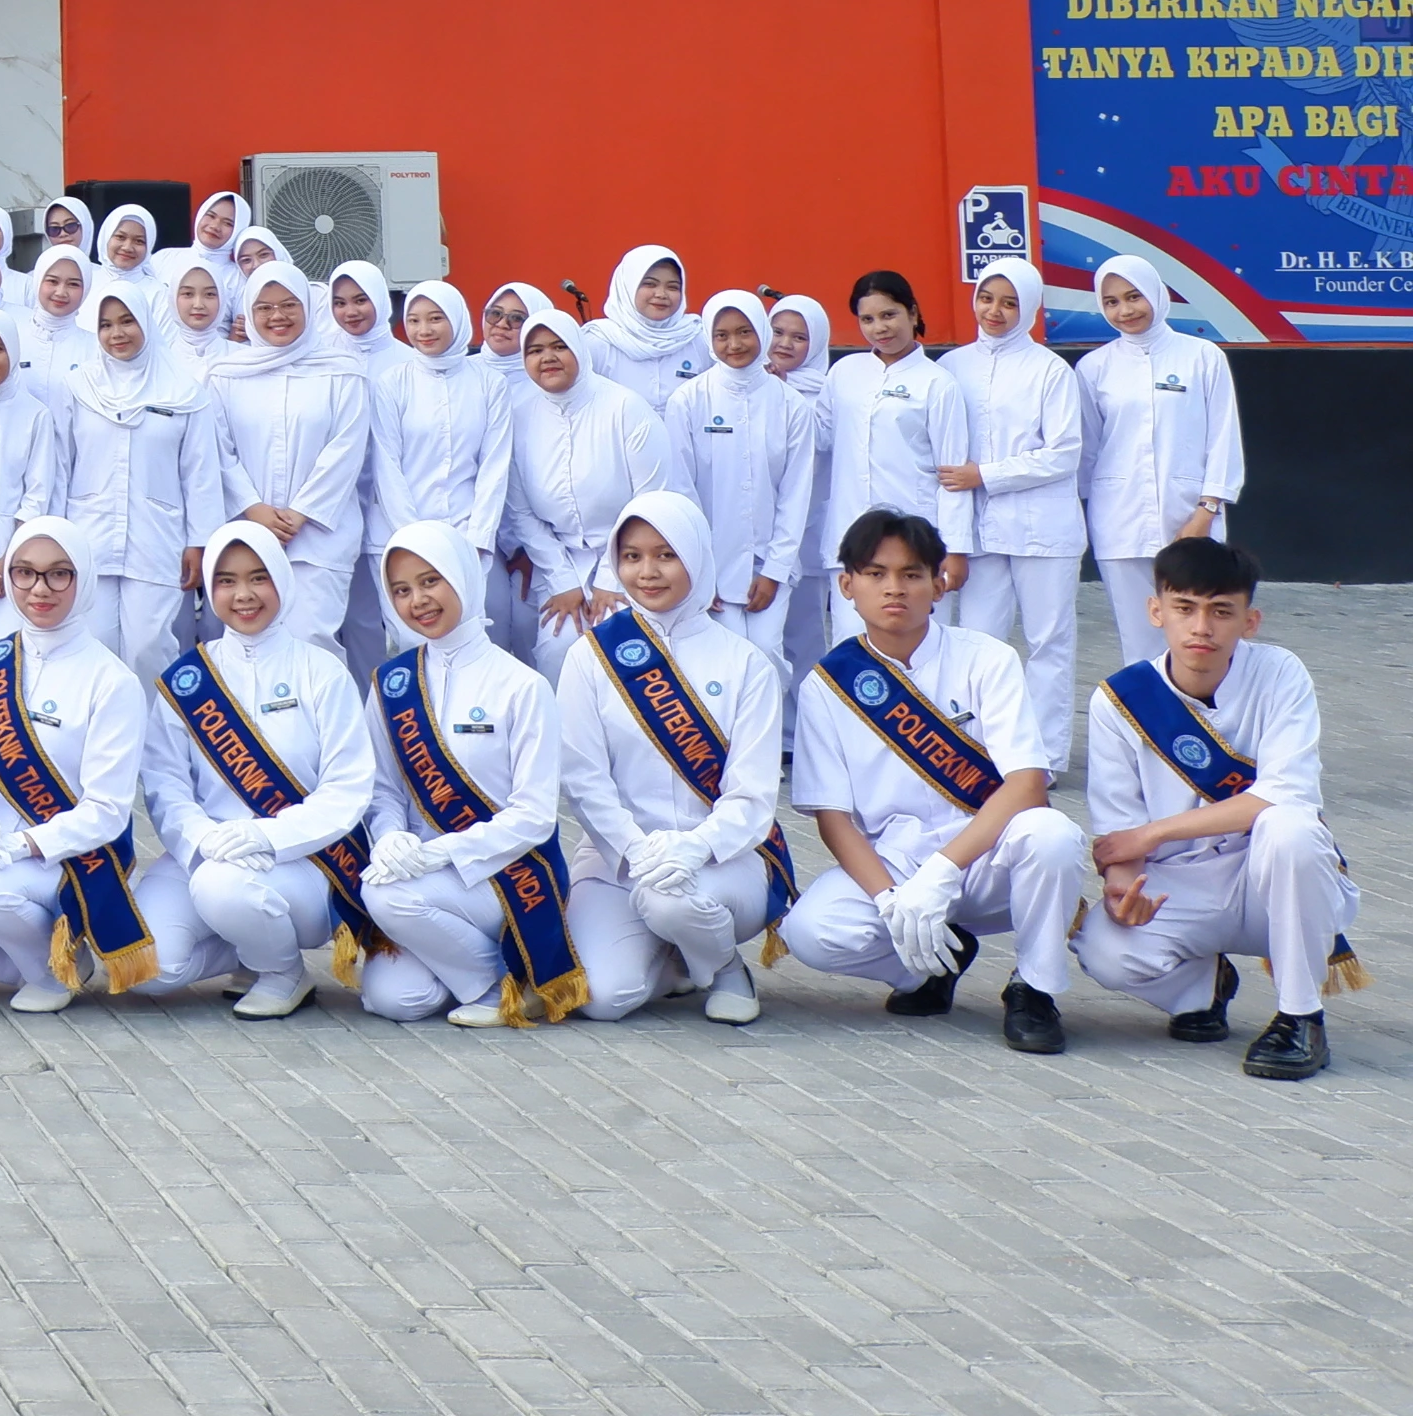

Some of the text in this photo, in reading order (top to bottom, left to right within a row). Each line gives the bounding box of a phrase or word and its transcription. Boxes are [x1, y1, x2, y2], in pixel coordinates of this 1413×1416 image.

[1042, 47, 1174, 78] TANYA
[1187, 46, 1344, 78] KEPADA
[1213, 105, 1400, 137] APA BAGI
[1166, 164, 1413, 197] AKU CINTA
[965, 193, 990, 223] P
[1279, 251, 1311, 269] Dr.
[1317, 251, 1342, 269] H.
[1347, 251, 1369, 269] E.
[1375, 251, 1394, 269] K
[1314, 276, 1385, 293] Founder
[635, 667, 717, 771] POLITEKNIK
[192, 697, 275, 800] POLITEKNIK
[391, 707, 463, 813] POLITEKNIK
[884, 701, 989, 795] POLITEKNIK
[13, 764, 62, 823] TIARA
[502, 860, 546, 914] UNDA
